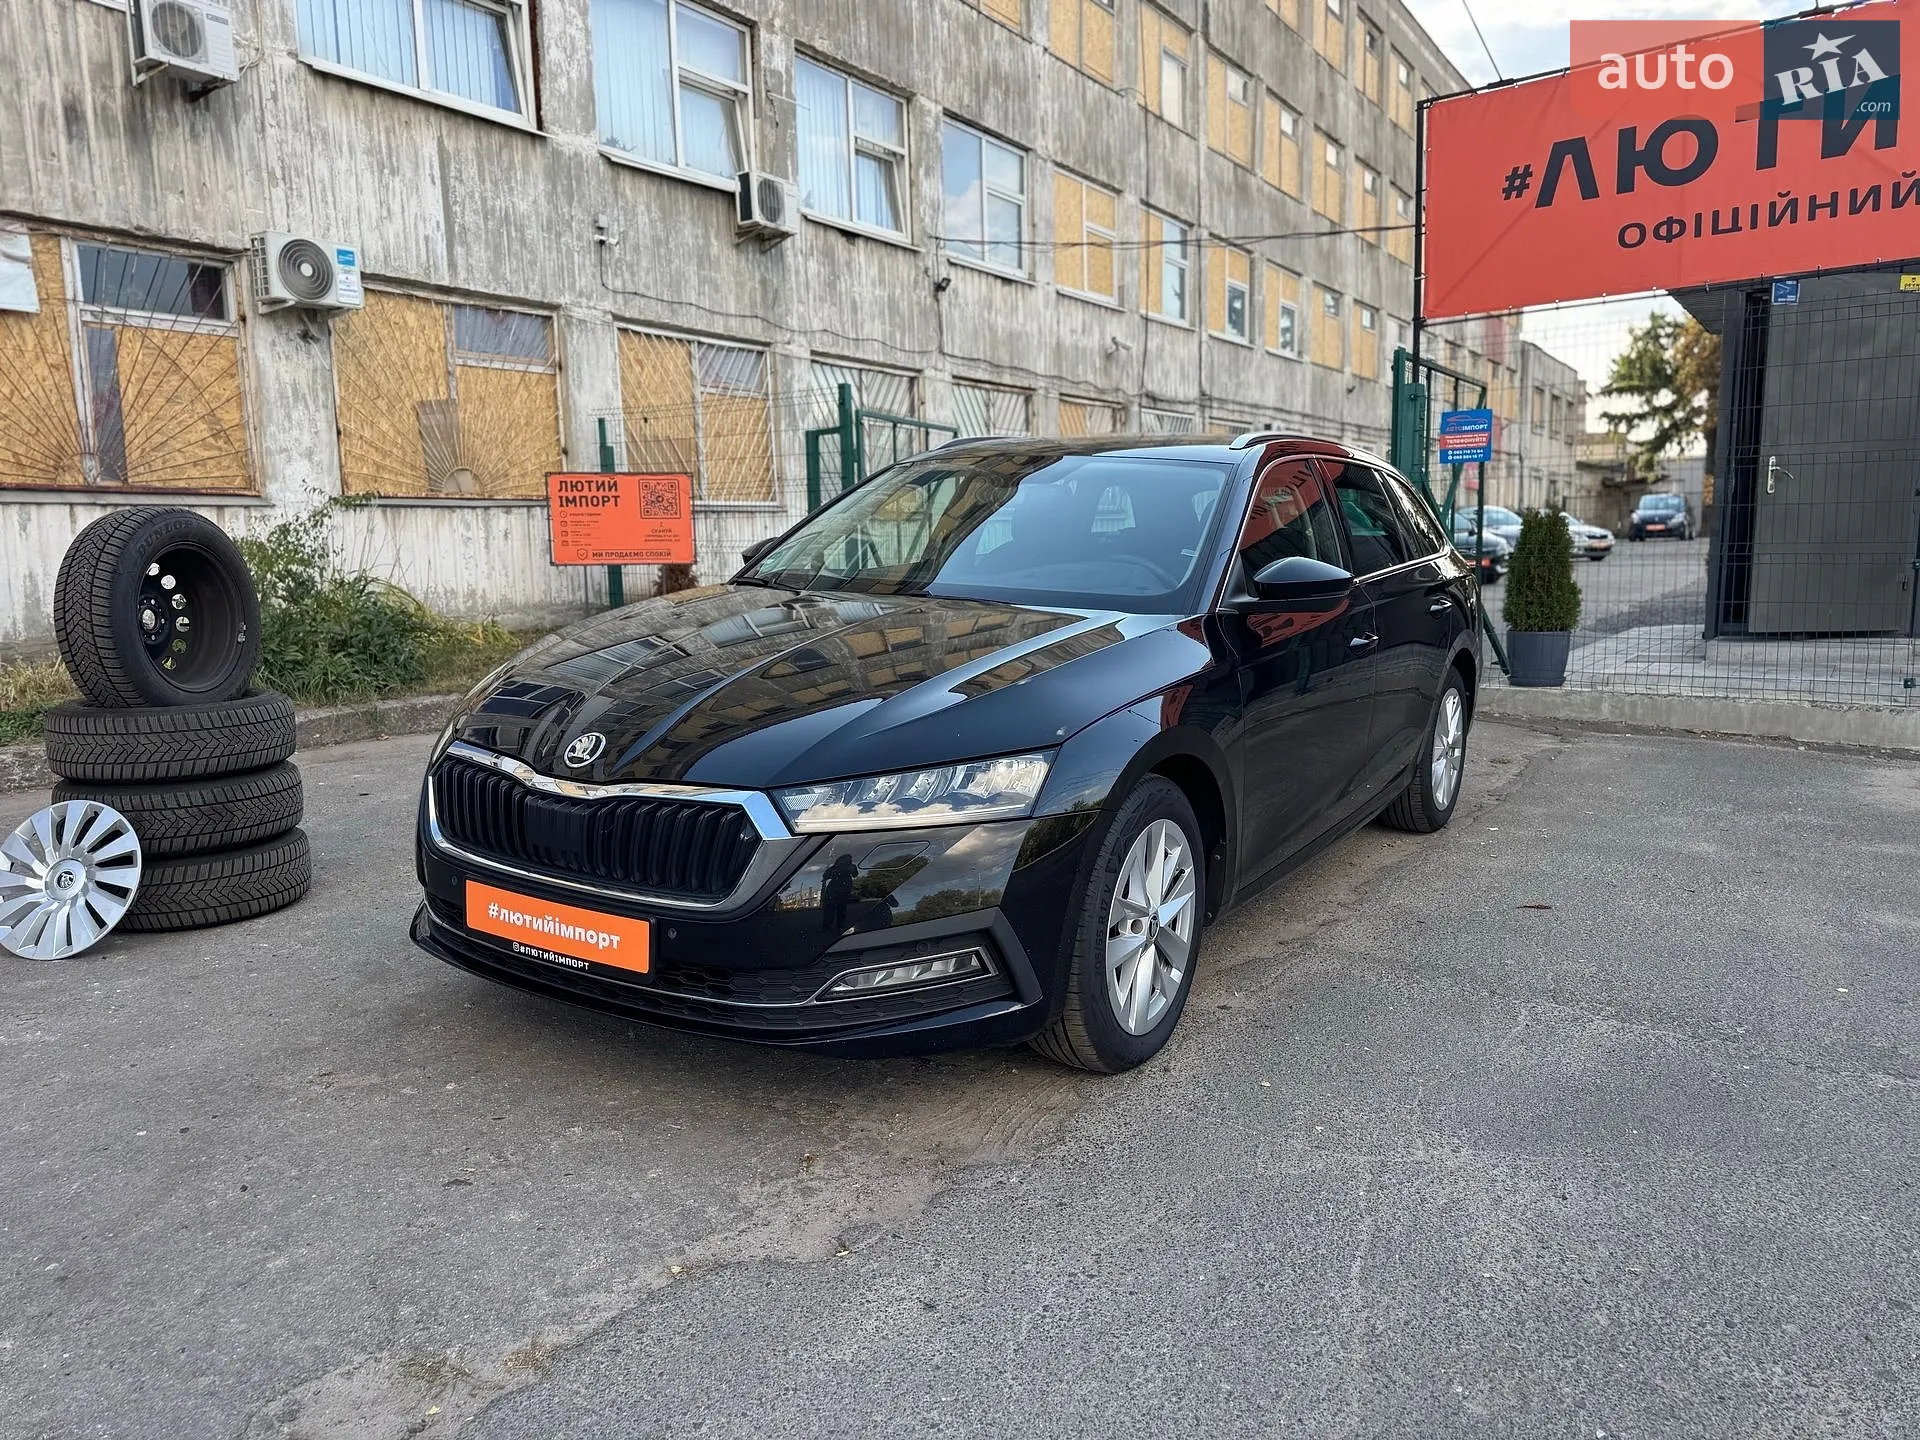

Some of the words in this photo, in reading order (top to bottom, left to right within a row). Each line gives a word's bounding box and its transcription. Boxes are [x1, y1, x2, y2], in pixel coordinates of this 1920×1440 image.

[558, 477, 618, 492] ЛЮТИЙ
[558, 495, 620, 507] ІМПОРТ
[487, 902, 621, 949] #лютийімпорт
